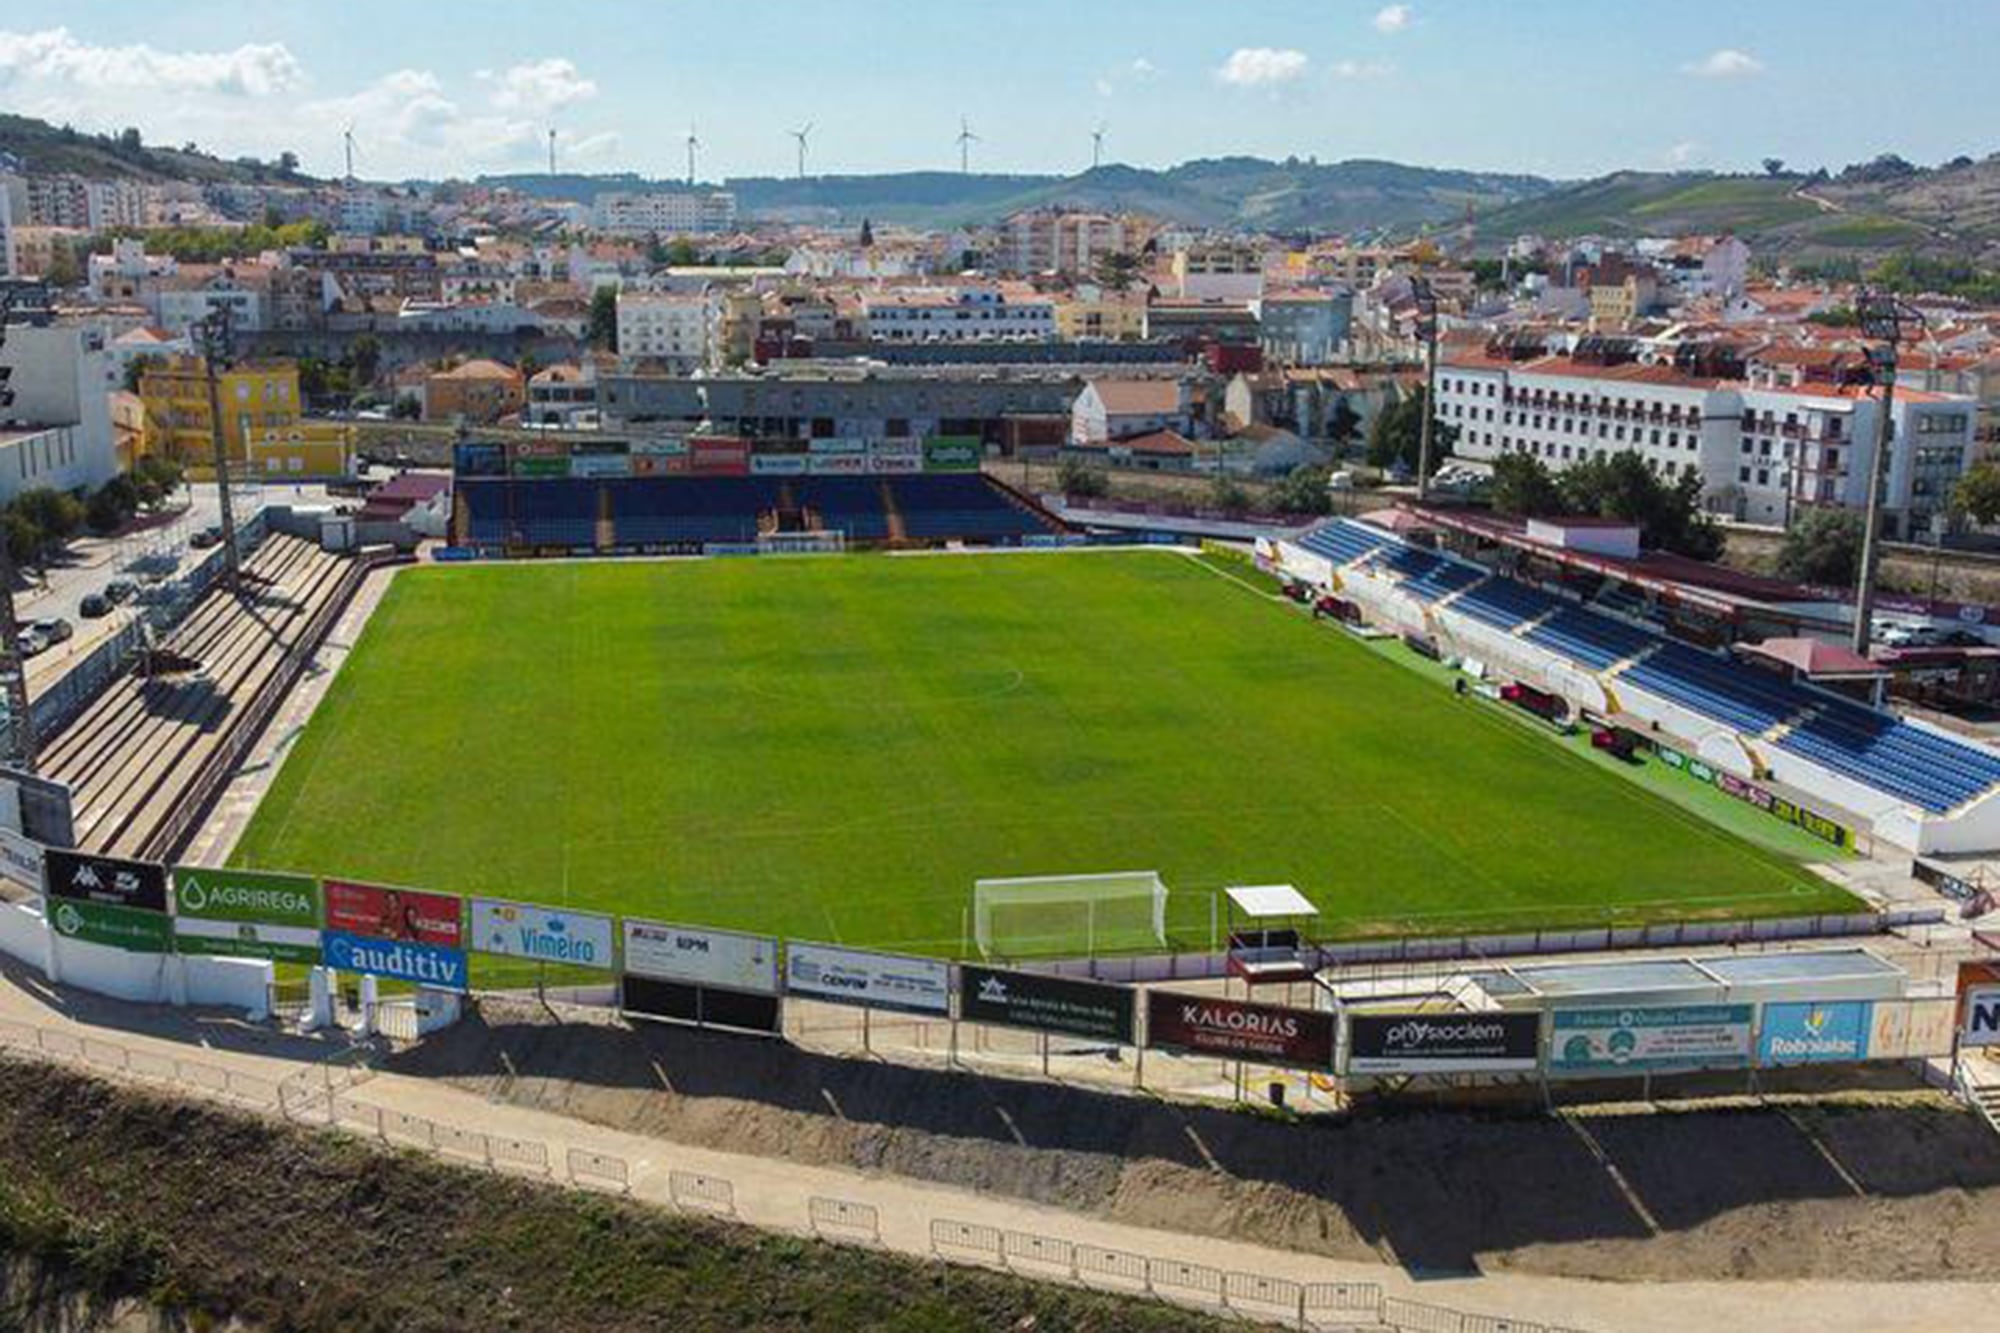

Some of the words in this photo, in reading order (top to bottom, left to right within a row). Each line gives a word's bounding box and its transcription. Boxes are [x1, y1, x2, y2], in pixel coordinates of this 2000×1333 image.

[209, 886, 311, 912] AGRIREGA
[520, 926, 595, 962] Vimeiro
[351, 945, 458, 982] auditiv
[1182, 1004, 1299, 1038] KALORIAS
